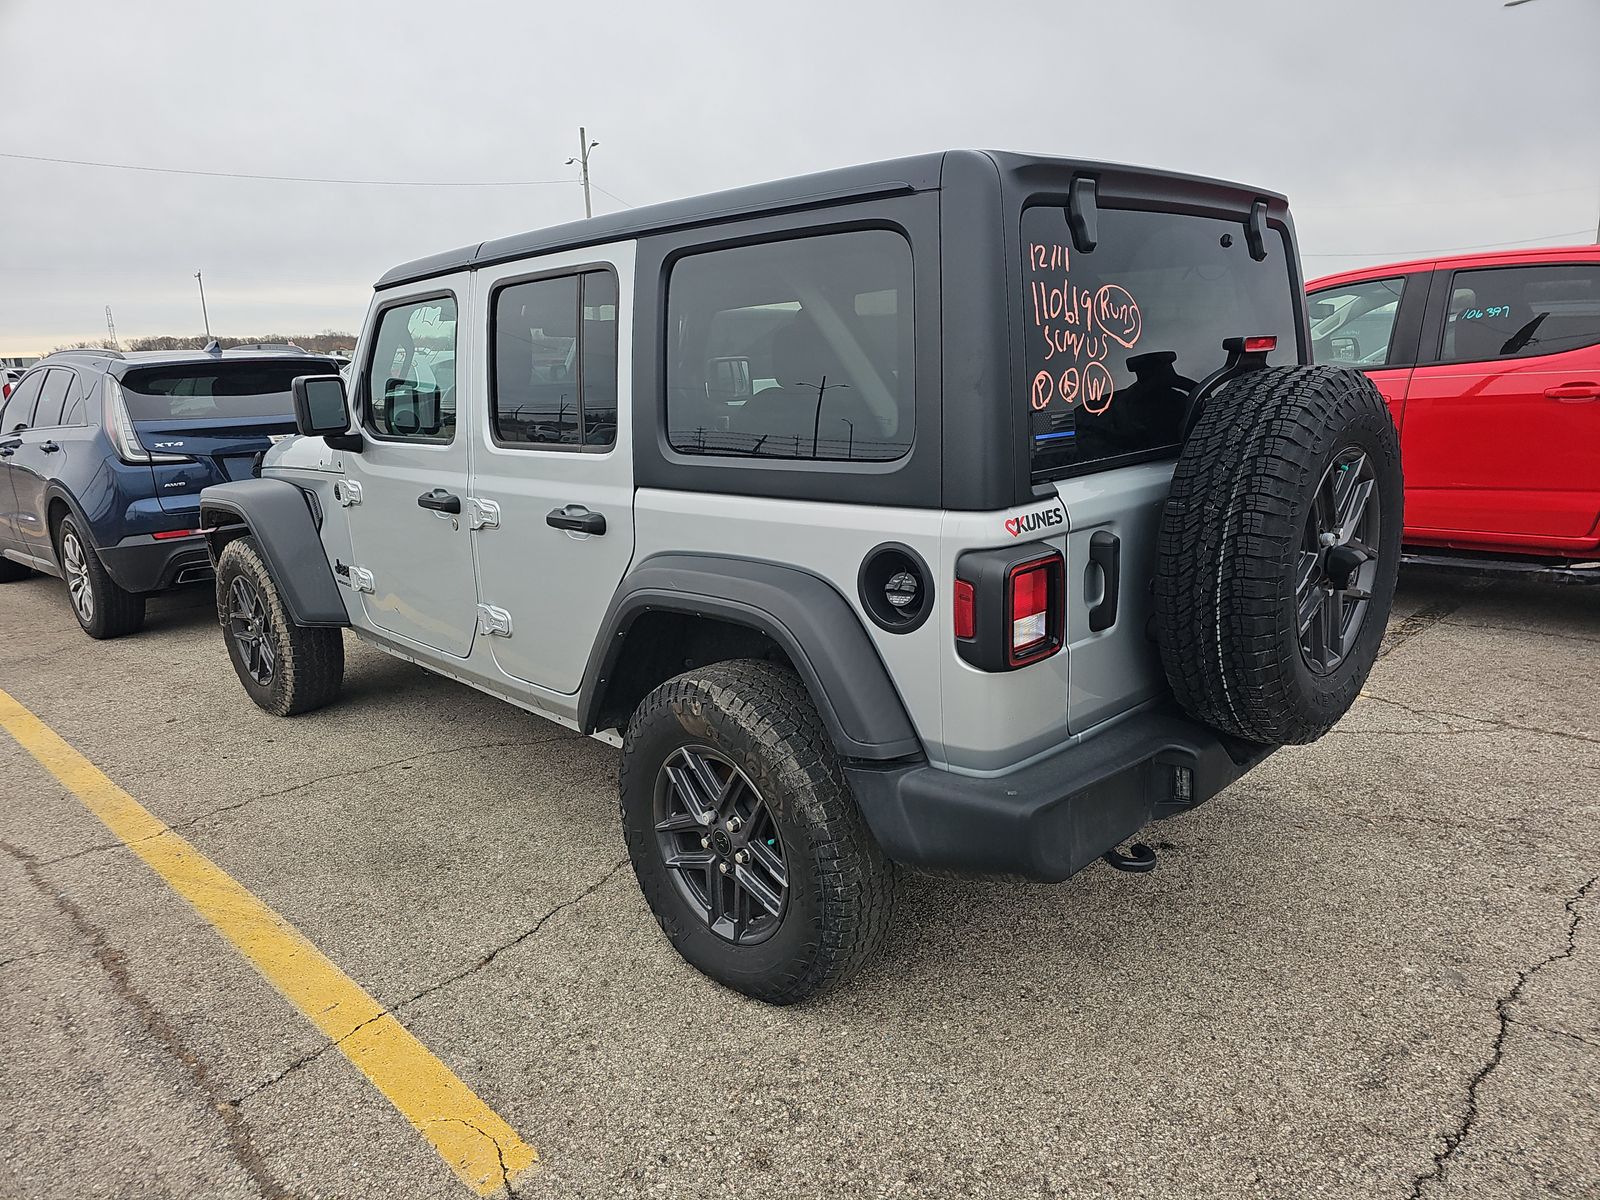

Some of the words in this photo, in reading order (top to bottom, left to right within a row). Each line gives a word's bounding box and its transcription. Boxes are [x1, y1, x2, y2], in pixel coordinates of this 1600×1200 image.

[1030, 242, 1070, 272] 12/11
[1031, 279, 1092, 334] 110619
[1461, 308, 1484, 320] 106
[1486, 305, 1510, 318] 397
[1016, 507, 1063, 534] KUNES
